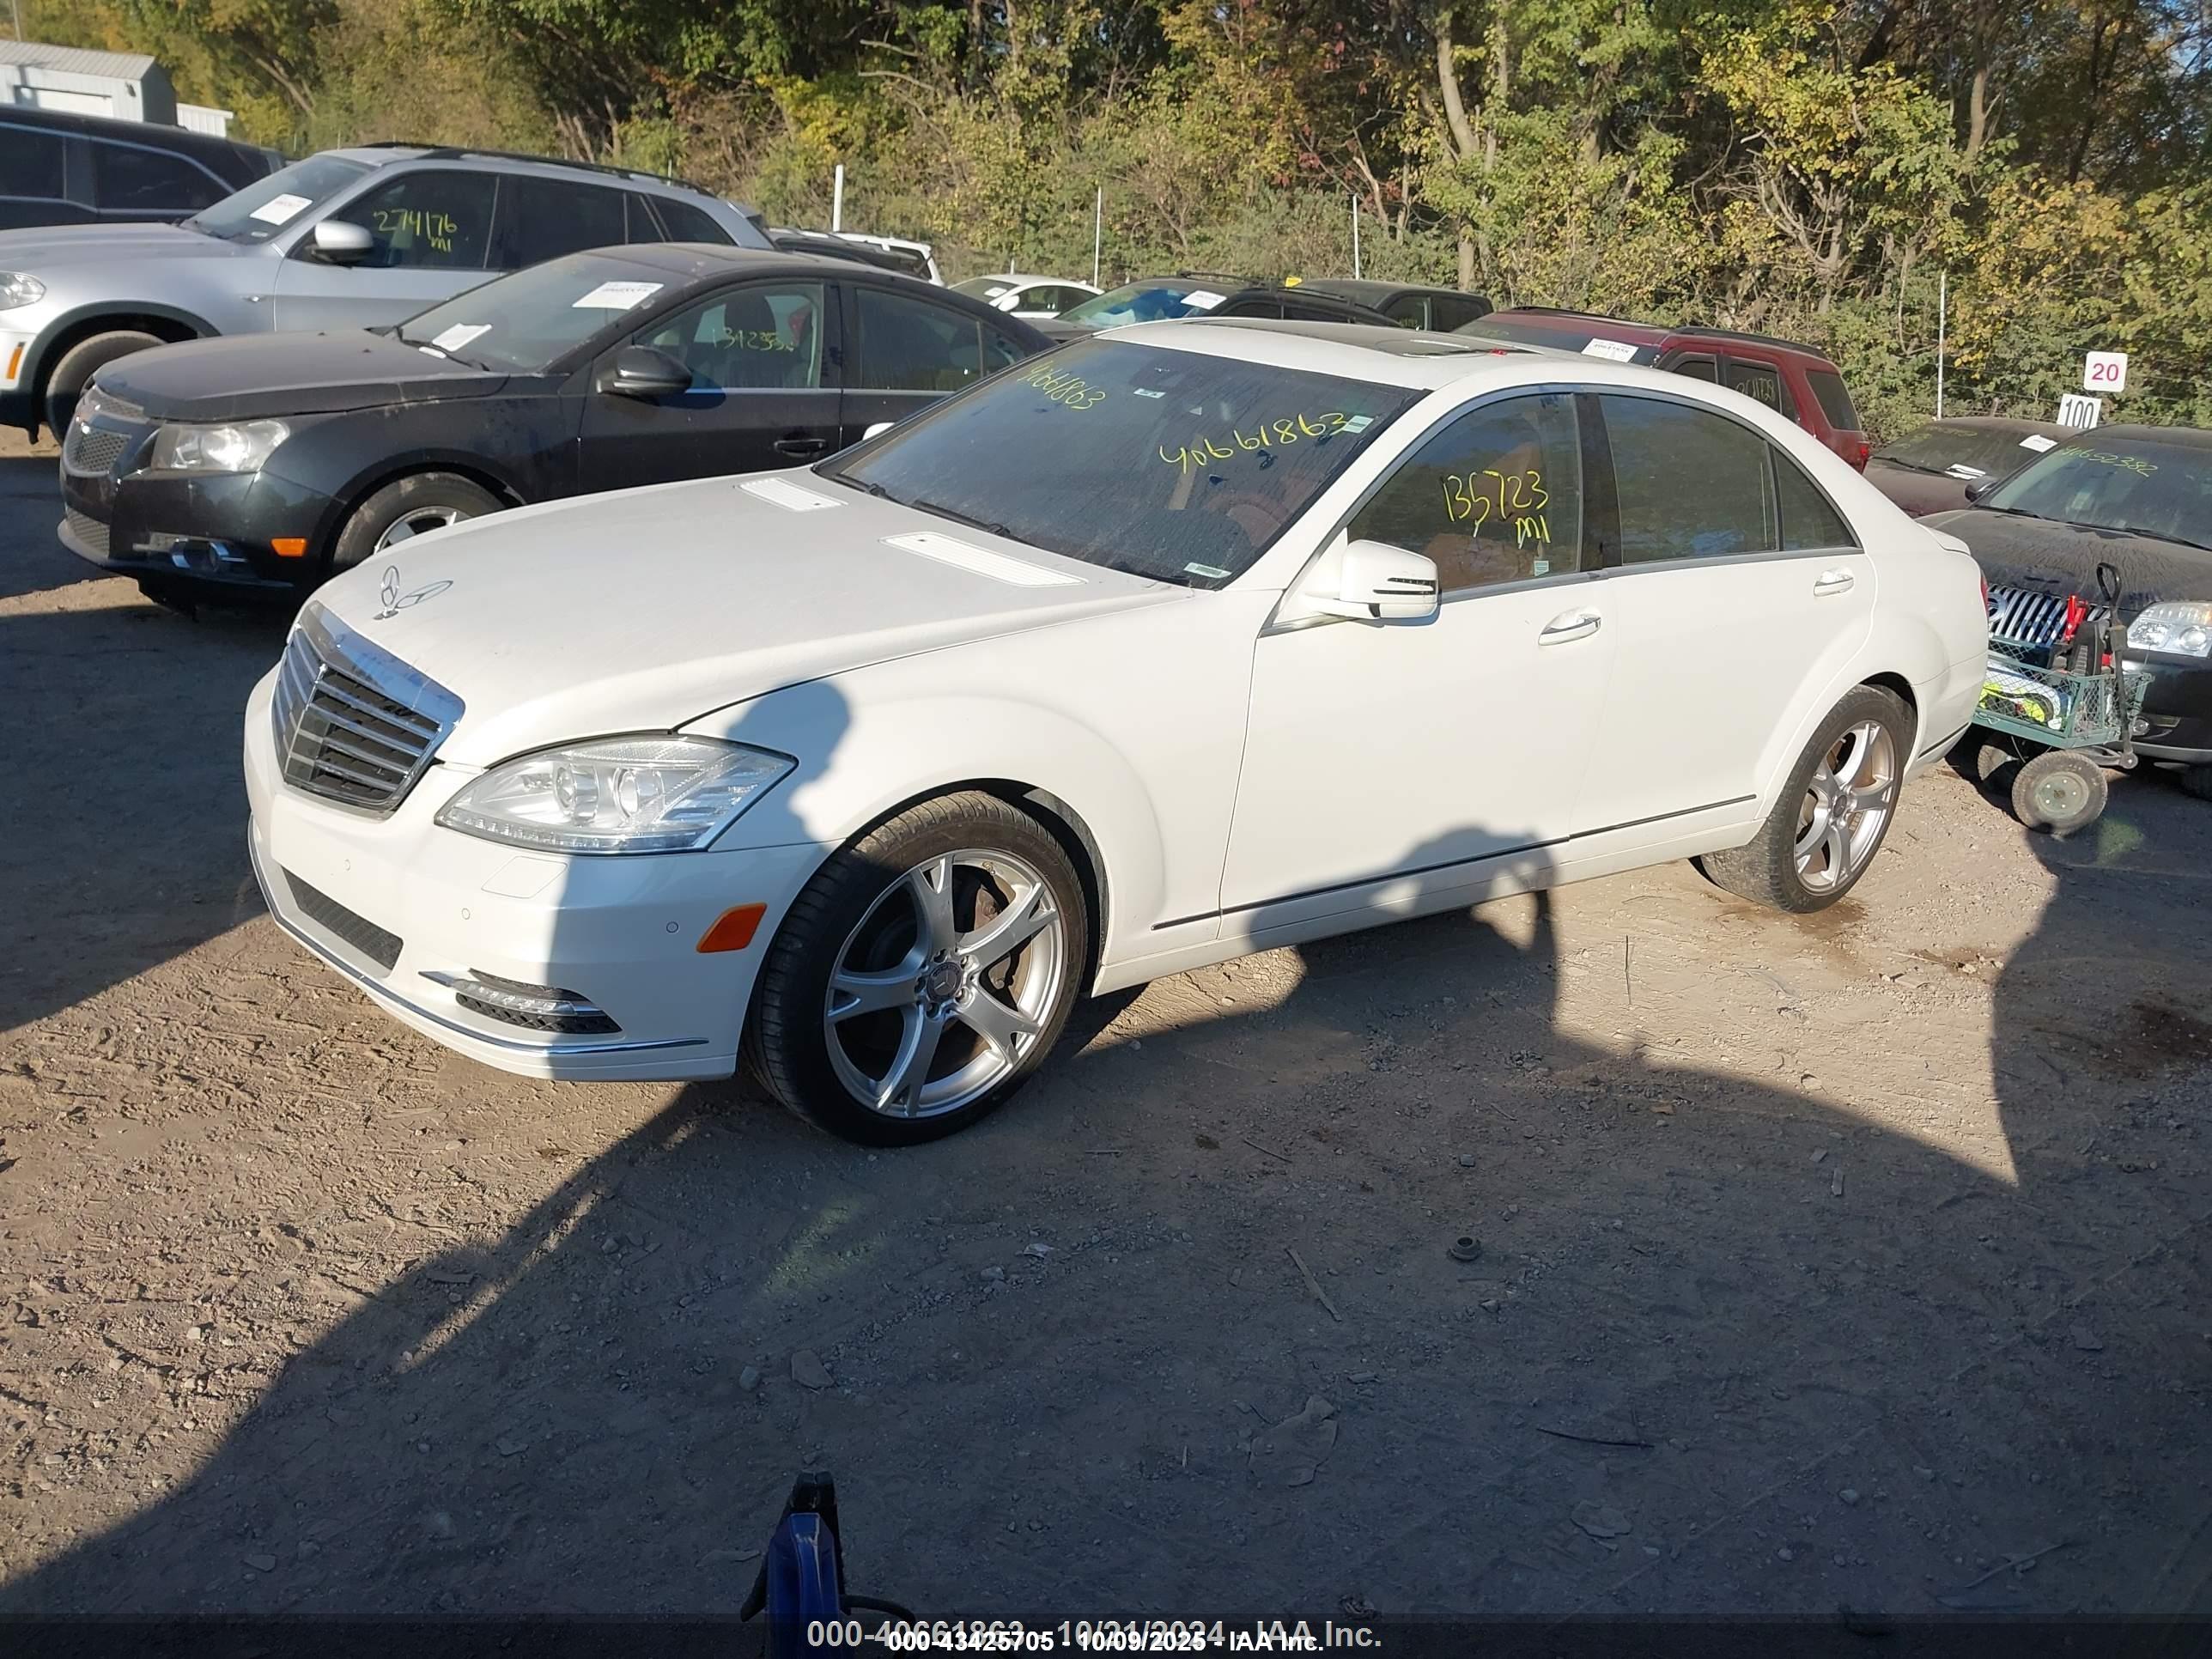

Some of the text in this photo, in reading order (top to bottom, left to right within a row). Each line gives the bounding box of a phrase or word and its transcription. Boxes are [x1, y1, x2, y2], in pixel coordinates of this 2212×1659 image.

[373, 208, 459, 240] 274176
[1017, 360, 1106, 410] 40661863
[2092, 362, 2119, 382] 20
[2065, 398, 2095, 429] 100
[1159, 412, 1347, 475] 40661863
[1443, 470, 1549, 538] 135723
